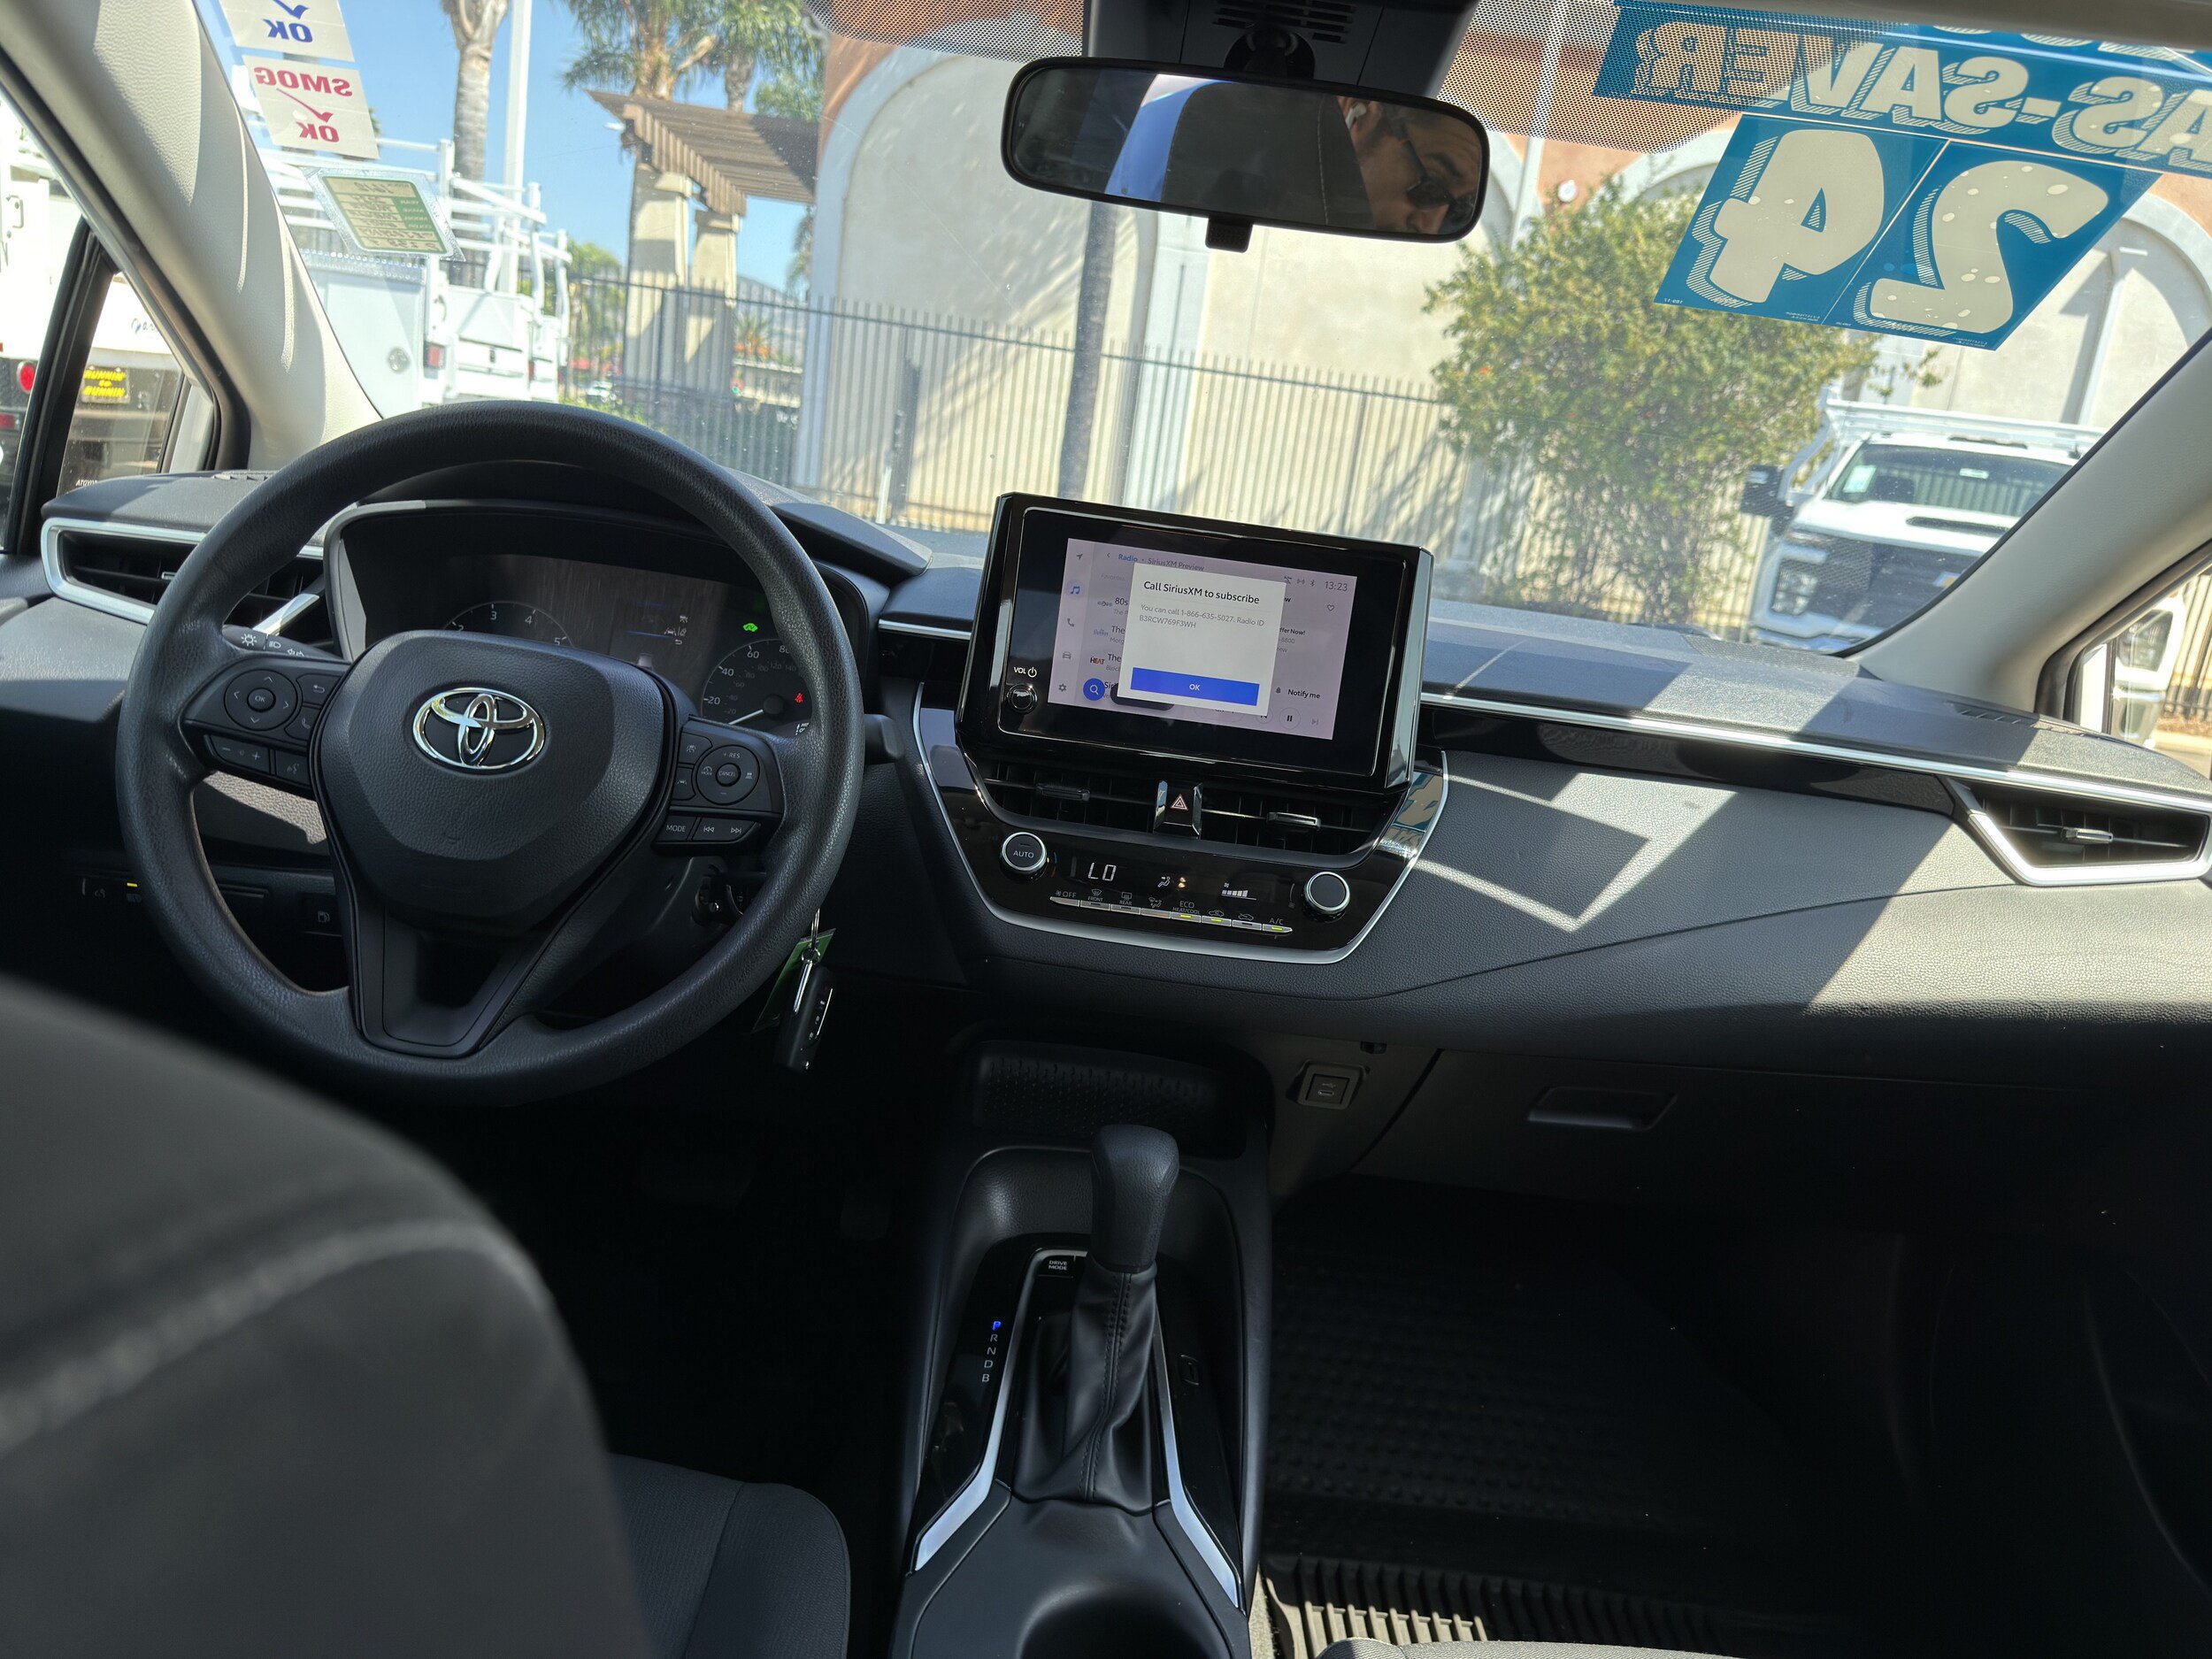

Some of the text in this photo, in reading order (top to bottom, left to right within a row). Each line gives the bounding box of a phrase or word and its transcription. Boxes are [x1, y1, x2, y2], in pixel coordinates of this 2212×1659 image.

[1118, 553, 1205, 572] Radio SiriusXM Preview
[1325, 580, 1348, 592] 13:23
[1143, 580, 1260, 604] Call SiriusXM to subscribe
[1115, 596, 1129, 606] 80s
[490, 611, 497, 620] 3
[1141, 603, 1153, 612] You
[1237, 617, 1256, 626] Radio
[525, 615, 533, 625] 4
[1111, 625, 1125, 634] The
[554, 637, 561, 646] 5
[747, 650, 760, 659] 60
[1108, 654, 1121, 663] The
[721, 667, 734, 677] 40
[1287, 688, 1309, 699] Notify
[708, 695, 721, 705] 20
[1012, 850, 1034, 859] AUTO
[1087, 862, 1118, 882] LO
[1179, 900, 1195, 910] ECO
[992, 1320, 1002, 1331] P
[990, 1333, 998, 1342] R
[987, 1347, 997, 1356] N
[984, 1359, 994, 1369] D
[981, 1373, 990, 1383] B
